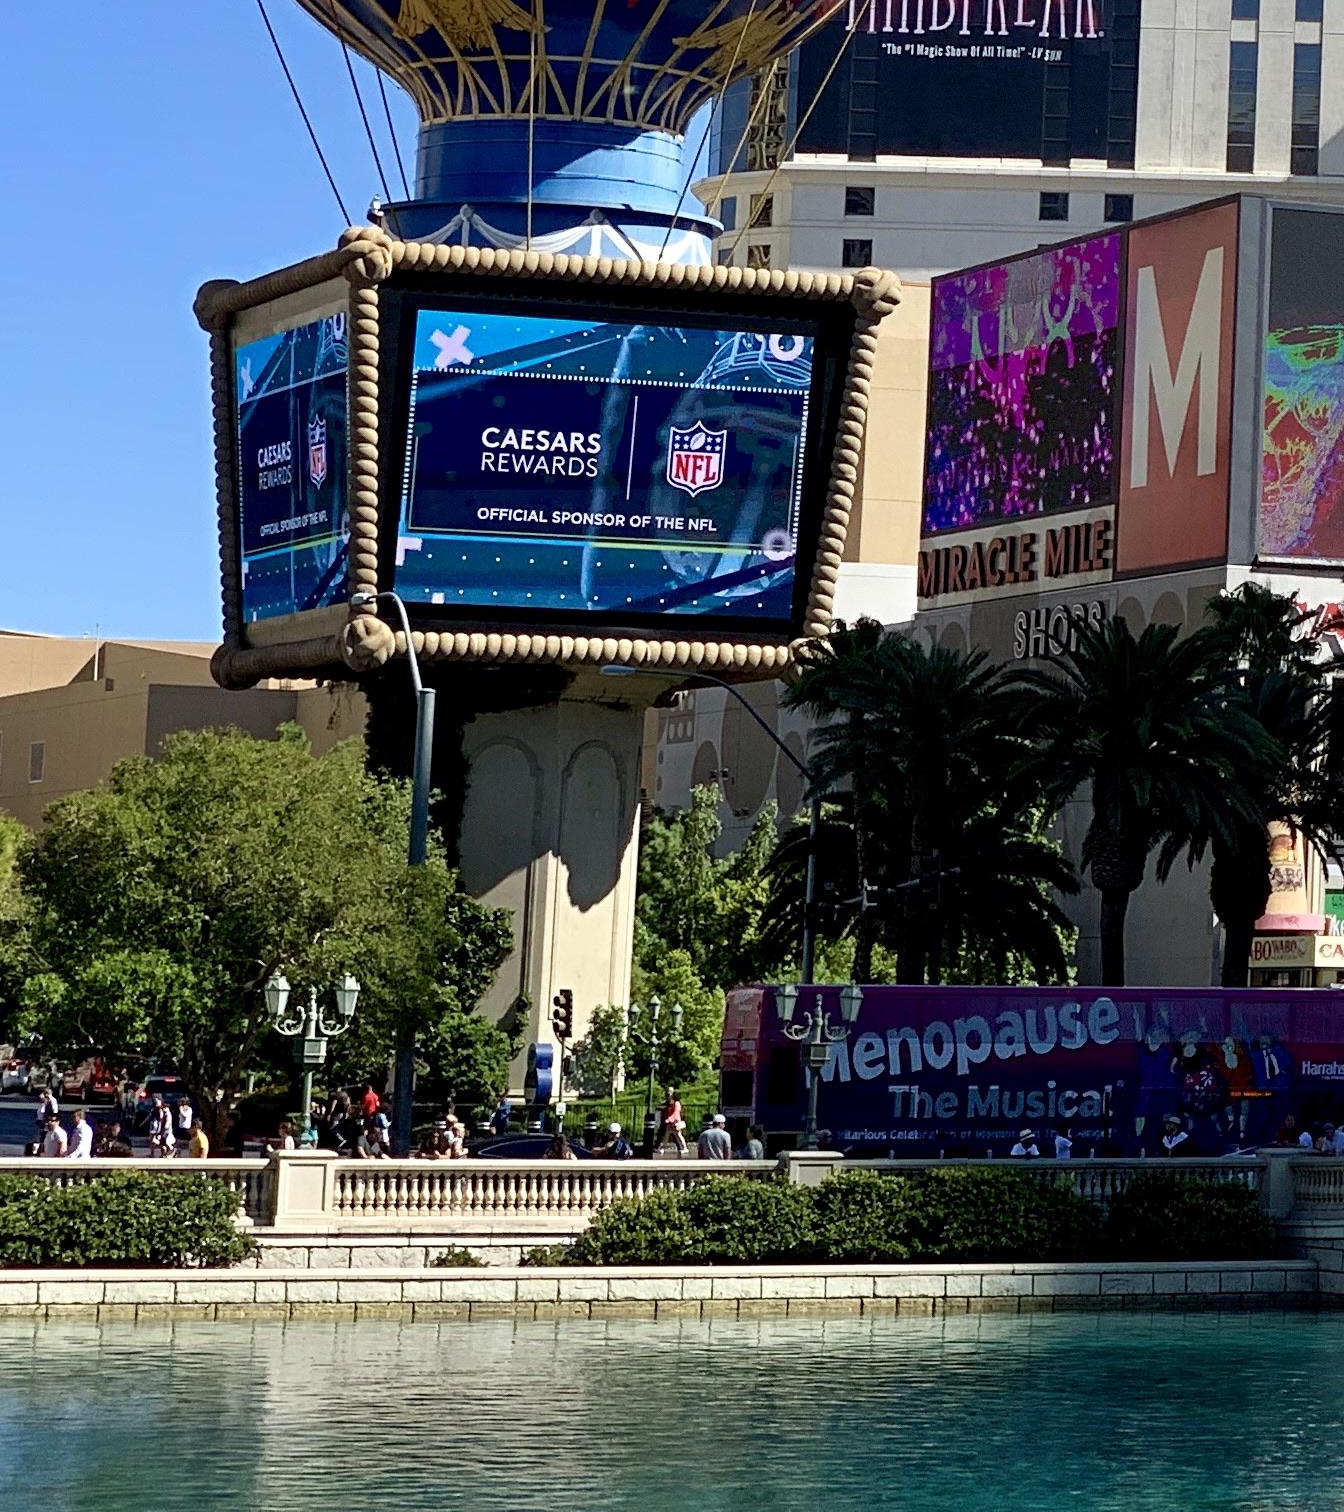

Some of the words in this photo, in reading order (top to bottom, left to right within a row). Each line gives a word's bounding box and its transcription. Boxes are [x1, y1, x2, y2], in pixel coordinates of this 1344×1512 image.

[916, 44, 944, 59] Magic
[945, 45, 968, 57] Show
[1129, 246, 1225, 489] M
[257, 440, 292, 469] CAESARS
[481, 426, 601, 454] CAESARS
[258, 464, 293, 491] REWARDS
[480, 451, 599, 478] REWARDS
[674, 453, 717, 485] NFL
[476, 507, 548, 523] OFFICIAL
[551, 511, 626, 527] SPONSOR
[629, 515, 652, 528] OF
[655, 516, 684, 530] THE
[688, 519, 717, 532] NFL
[917, 532, 1038, 599] MIRACLE
[1044, 519, 1112, 579] MILE
[805, 997, 1120, 1088] Menopause
[888, 1085, 958, 1118] The
[967, 1080, 1112, 1119] Musical
